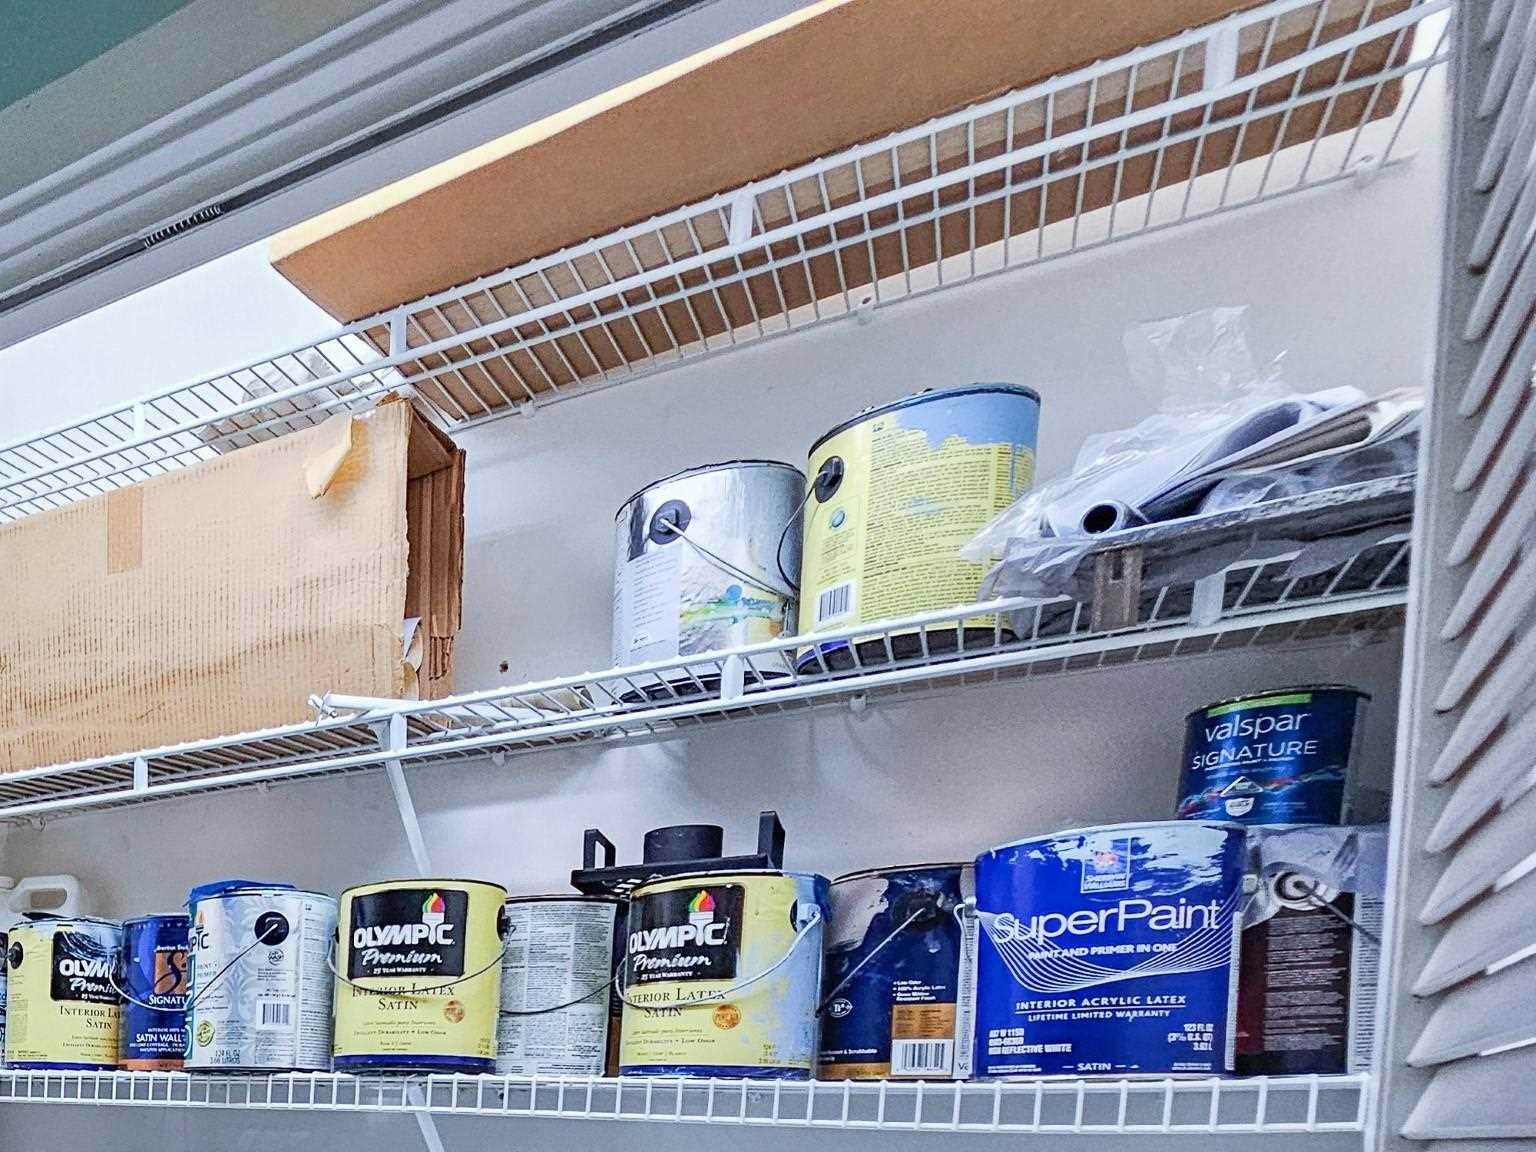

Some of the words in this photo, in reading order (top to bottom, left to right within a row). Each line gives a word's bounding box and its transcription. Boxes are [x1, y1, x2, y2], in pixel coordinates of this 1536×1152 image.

[1205, 711, 1311, 742] valspar
[1191, 740, 1319, 771] SIGNATURE
[992, 898, 1223, 946] SuperPaint
[353, 921, 455, 949] OLYMPIC
[629, 919, 727, 954] OLYMPIC
[361, 948, 443, 966] Premium
[1028, 949, 1058, 961] PAINT
[1062, 947, 1089, 958] AND
[1090, 944, 1134, 955] PRIMER
[1136, 943, 1151, 953] IN
[1152, 943, 1179, 953] ONE
[633, 953, 712, 973] Premium
[148, 995, 186, 1005] SIGNATU
[378, 998, 419, 1011] SATIN
[626, 992, 670, 1005] TERIOR
[1015, 998, 1076, 1011] INTERIOR
[1081, 996, 1141, 1007] ACRYLIC
[1146, 995, 1187, 1004] LATEX
[60, 1005, 105, 1018] INTERIOR
[643, 1007, 684, 1019] SATIN
[1028, 1012, 1069, 1022] LIFETIME
[1071, 1011, 1113, 1020] LIMITED
[1115, 1009, 1171, 1020] WARRANTY
[86, 1018, 113, 1030] SATIN
[135, 1033, 158, 1043] SATIN
[159, 1034, 181, 1042] WALL
[1077, 1062, 1112, 1071] SATIN
